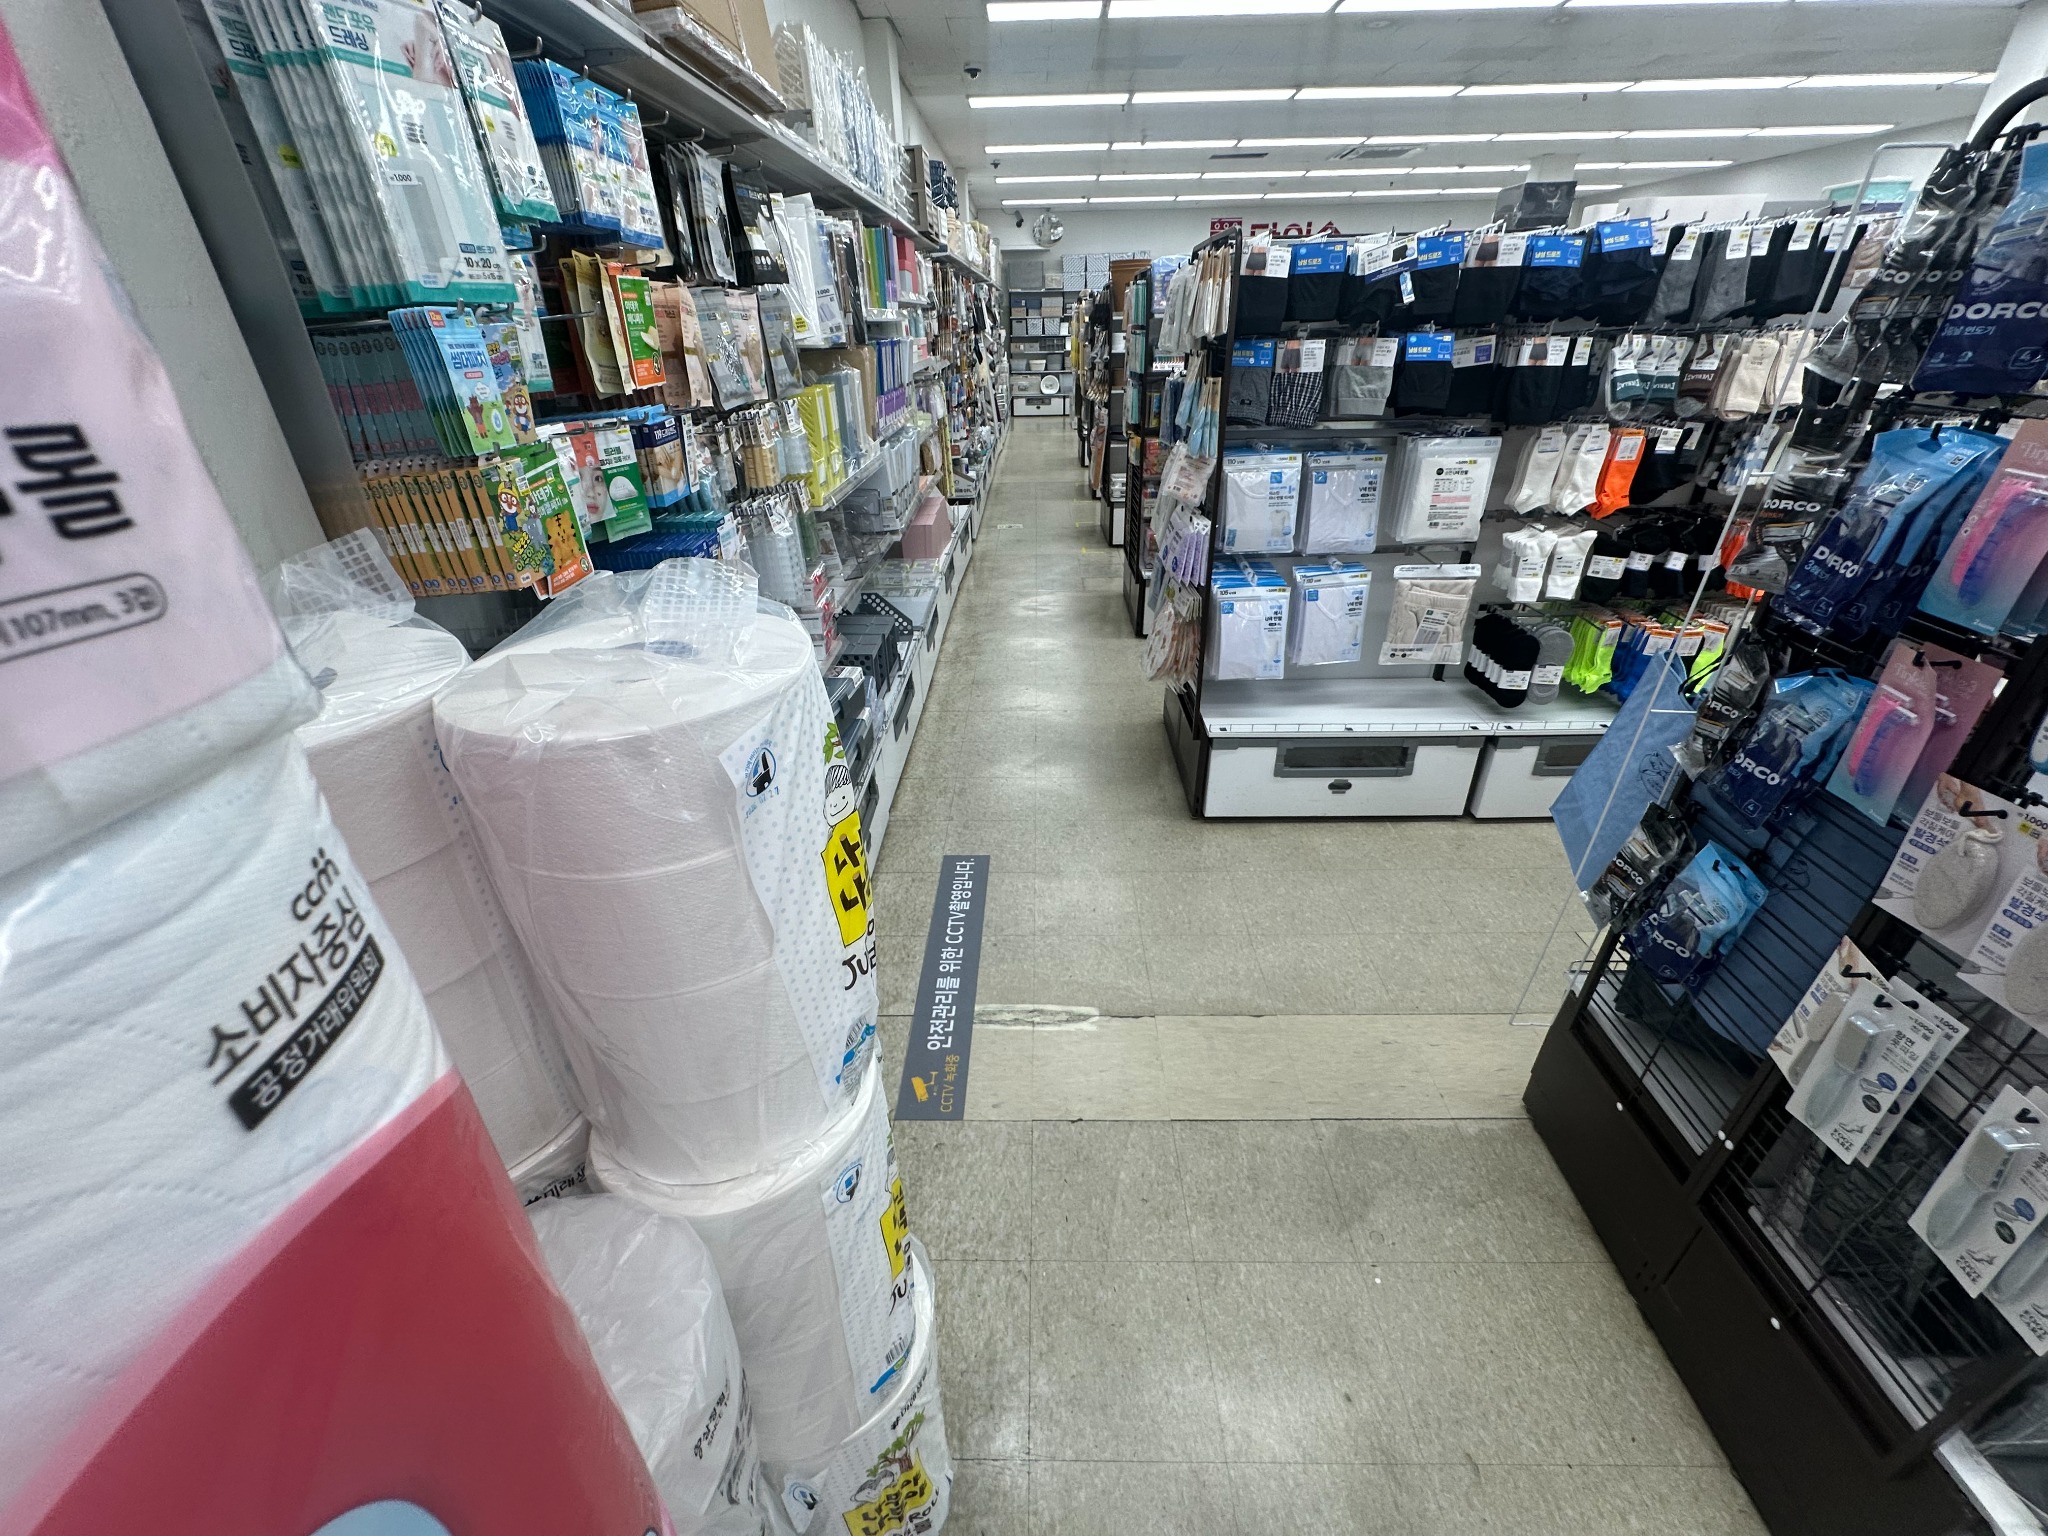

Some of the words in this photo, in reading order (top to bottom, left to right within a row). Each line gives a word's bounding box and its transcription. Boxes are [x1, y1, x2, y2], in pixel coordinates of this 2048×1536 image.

[328, 25, 369, 51] 드레싱
[450, 350, 489, 370] 썸머패치
[1813, 545, 1858, 579] DRCO
[1734, 753, 1781, 786] ORCO
[291, 847, 342, 922] ccm
[1648, 912, 1691, 958] DRCO
[938, 947, 963, 974] 위한
[206, 884, 367, 1087] 소비자중심
[249, 948, 380, 1109] 공정거래위원회
[926, 976, 961, 1051] 안전관리를
[944, 1054, 960, 1081] 녹화중
[940, 1080, 956, 1113] CCTV
